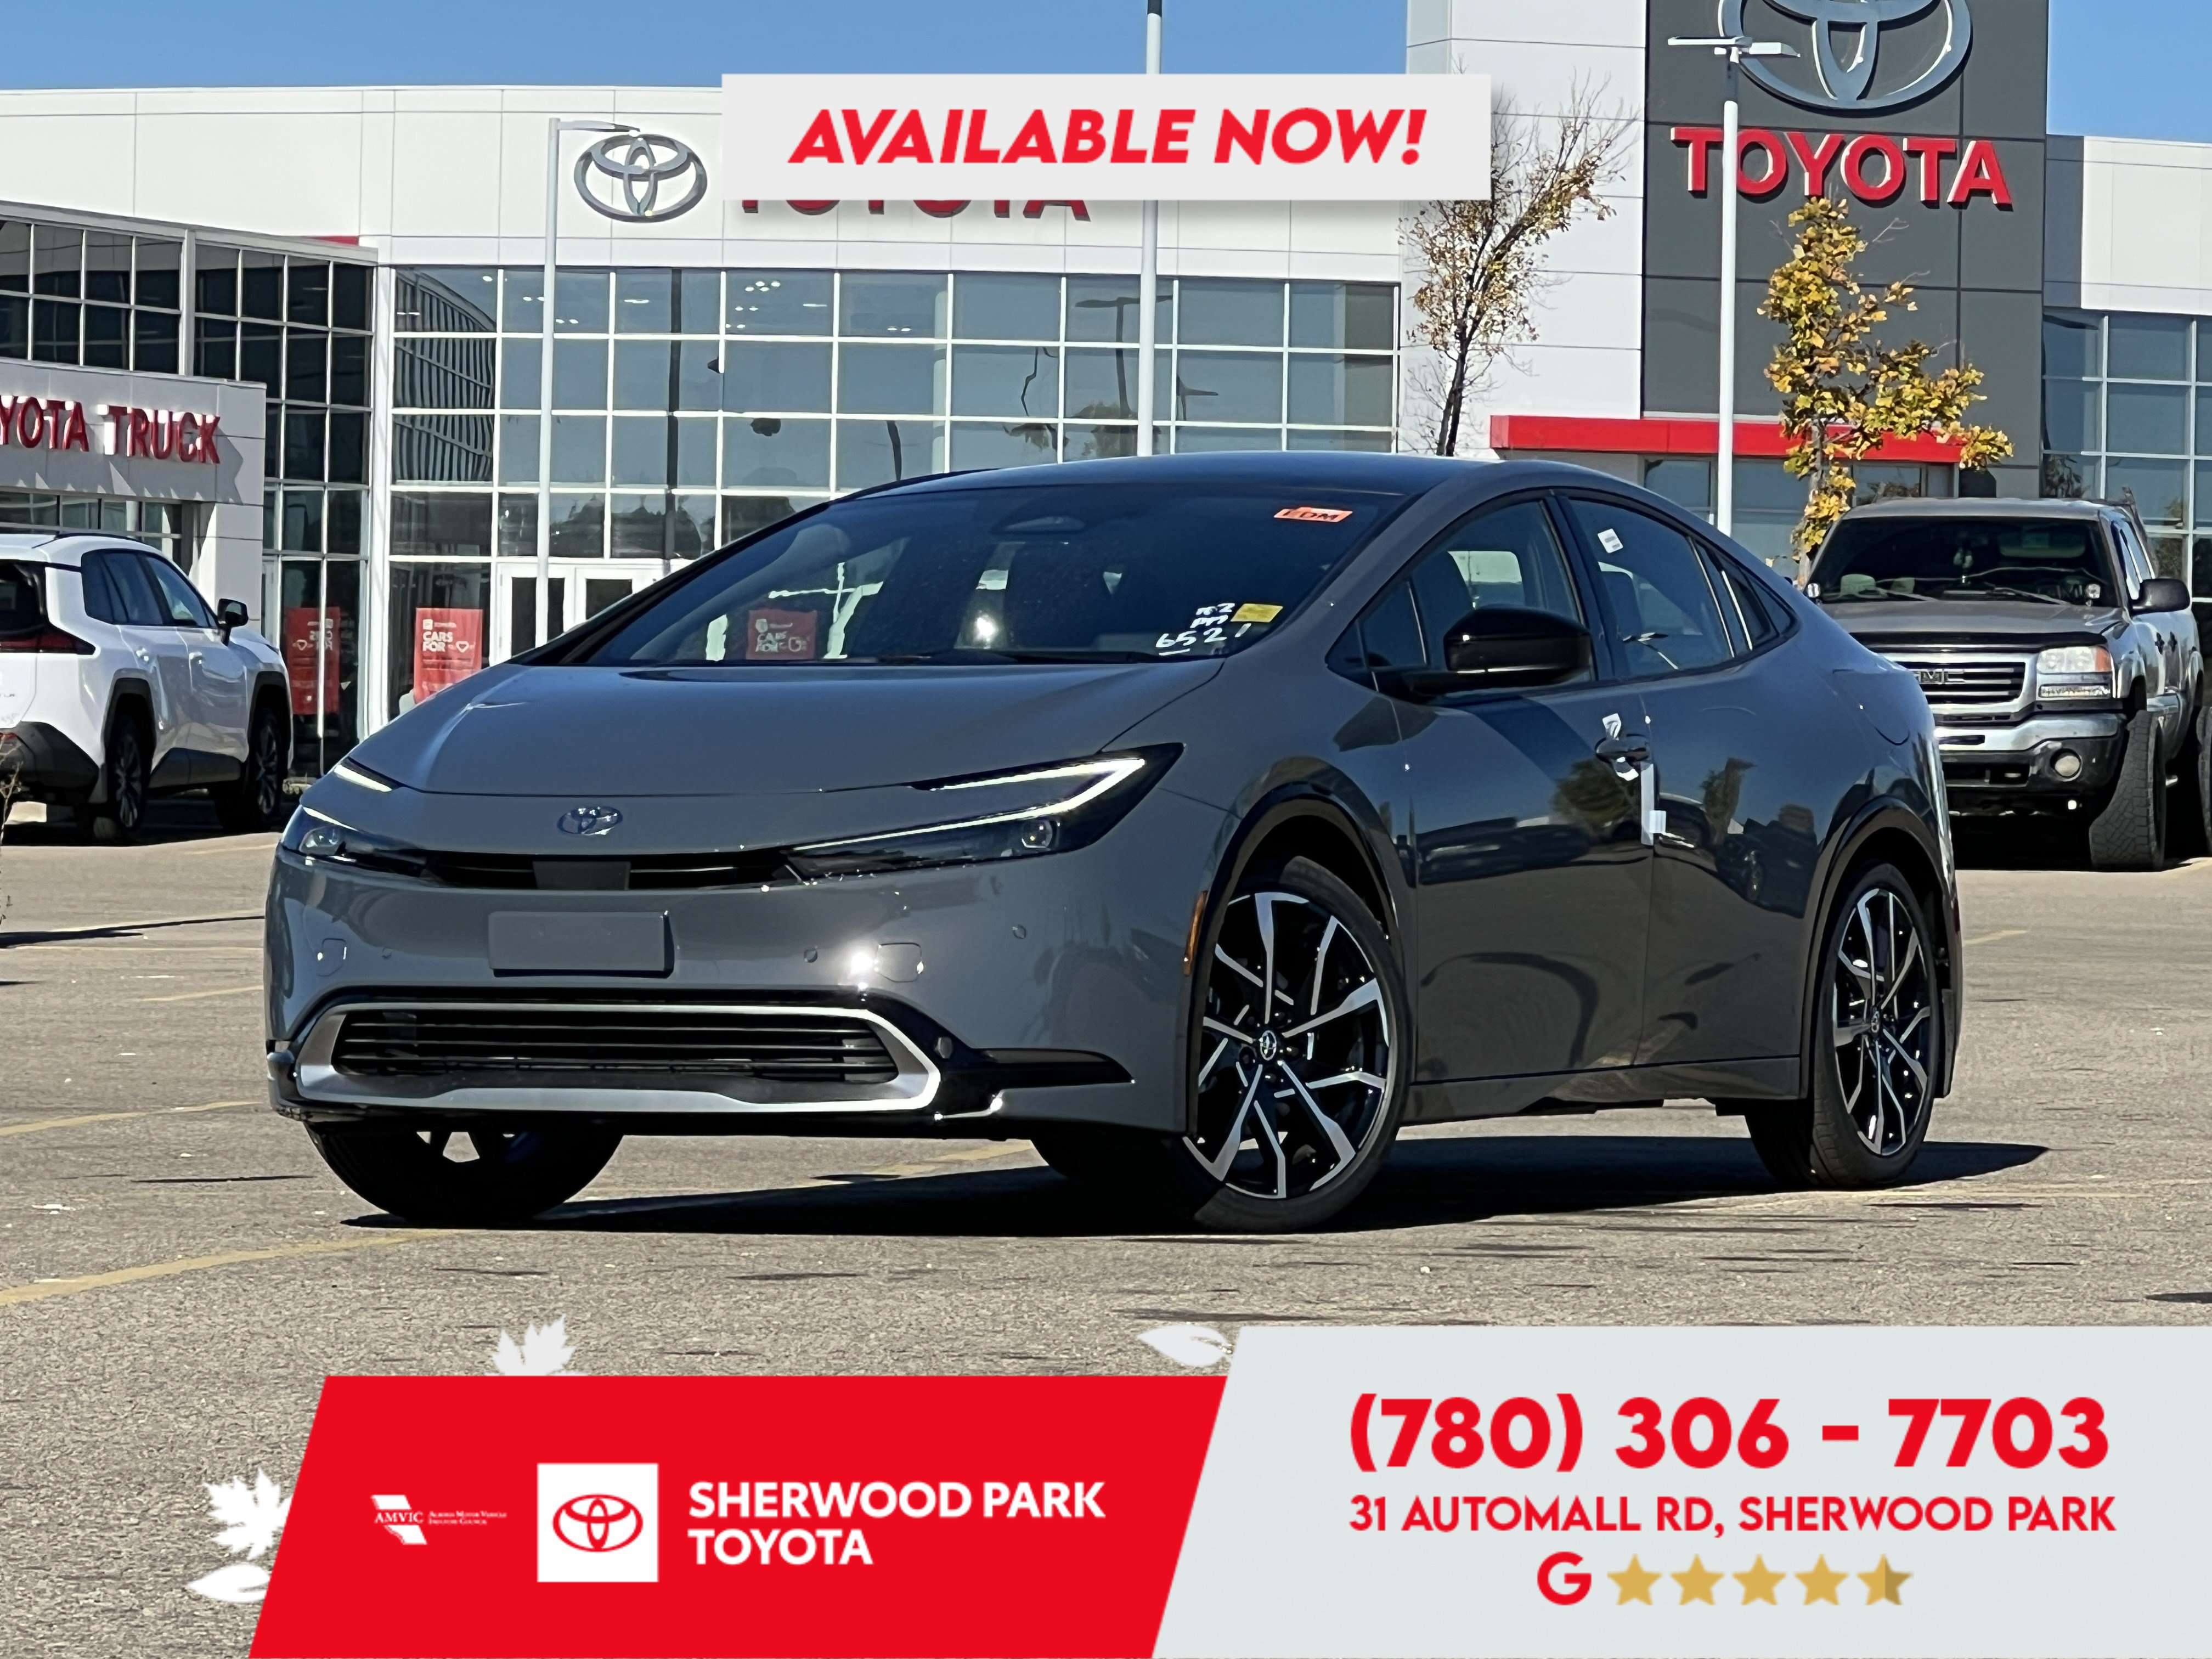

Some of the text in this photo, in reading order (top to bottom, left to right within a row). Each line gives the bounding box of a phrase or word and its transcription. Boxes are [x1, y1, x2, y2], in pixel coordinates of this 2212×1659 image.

[1671, 127, 2013, 205] TOYOTA
[98, 404, 221, 464] TRUCK
[422, 631, 453, 642] CARS
[422, 641, 446, 652] FOR
